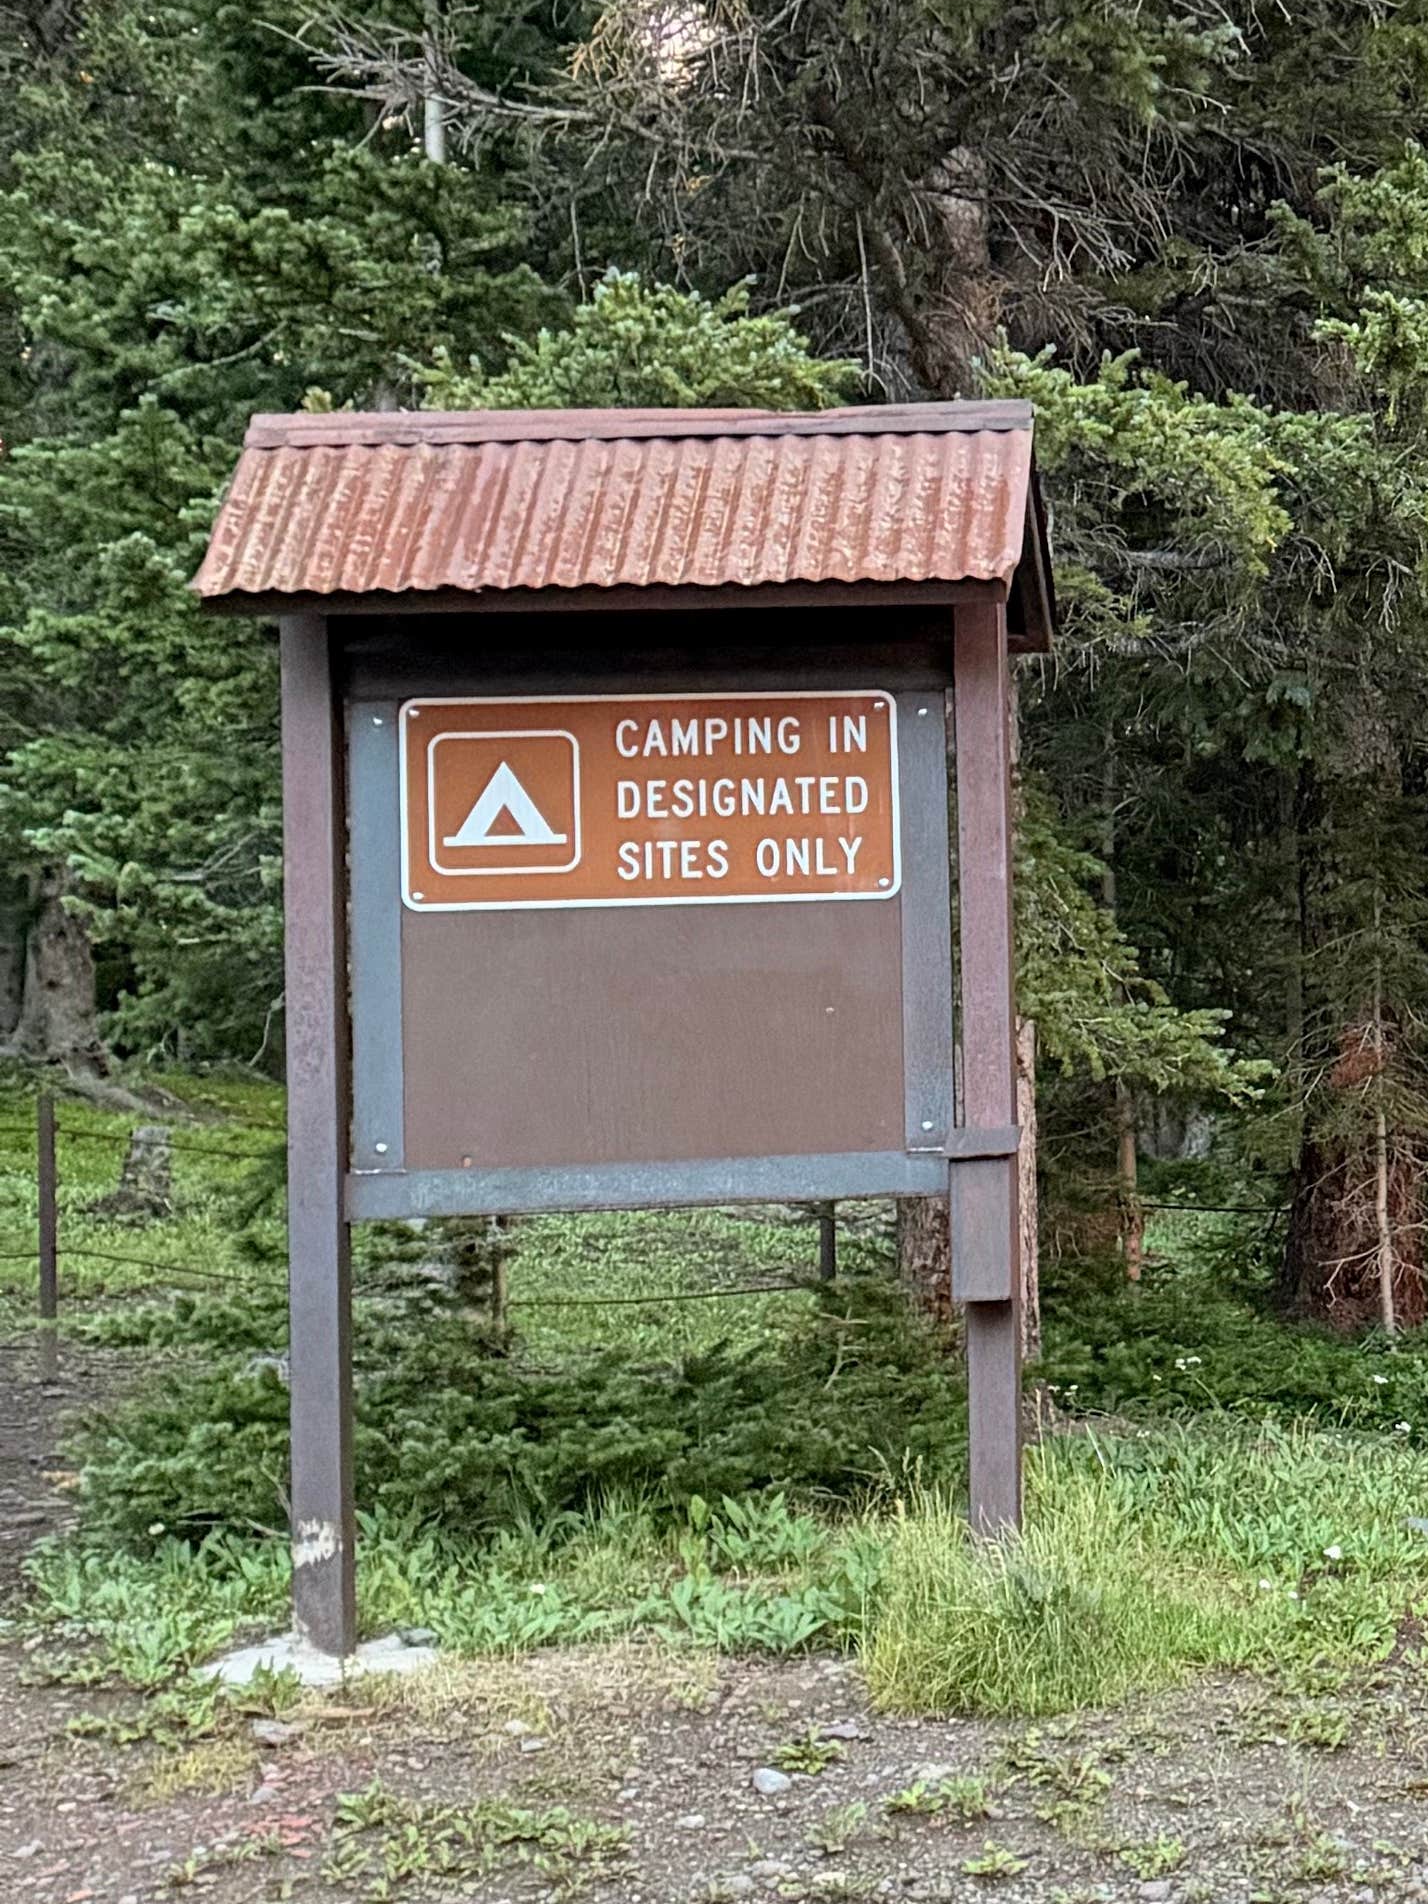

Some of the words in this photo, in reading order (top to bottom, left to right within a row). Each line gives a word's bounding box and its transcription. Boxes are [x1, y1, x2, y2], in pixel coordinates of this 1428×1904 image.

[616, 716, 800, 757] CAMPING
[829, 715, 867, 753] IN
[617, 776, 868, 818] DESIGNATED
[617, 839, 729, 880] SITES
[756, 836, 862, 877] ONLY
